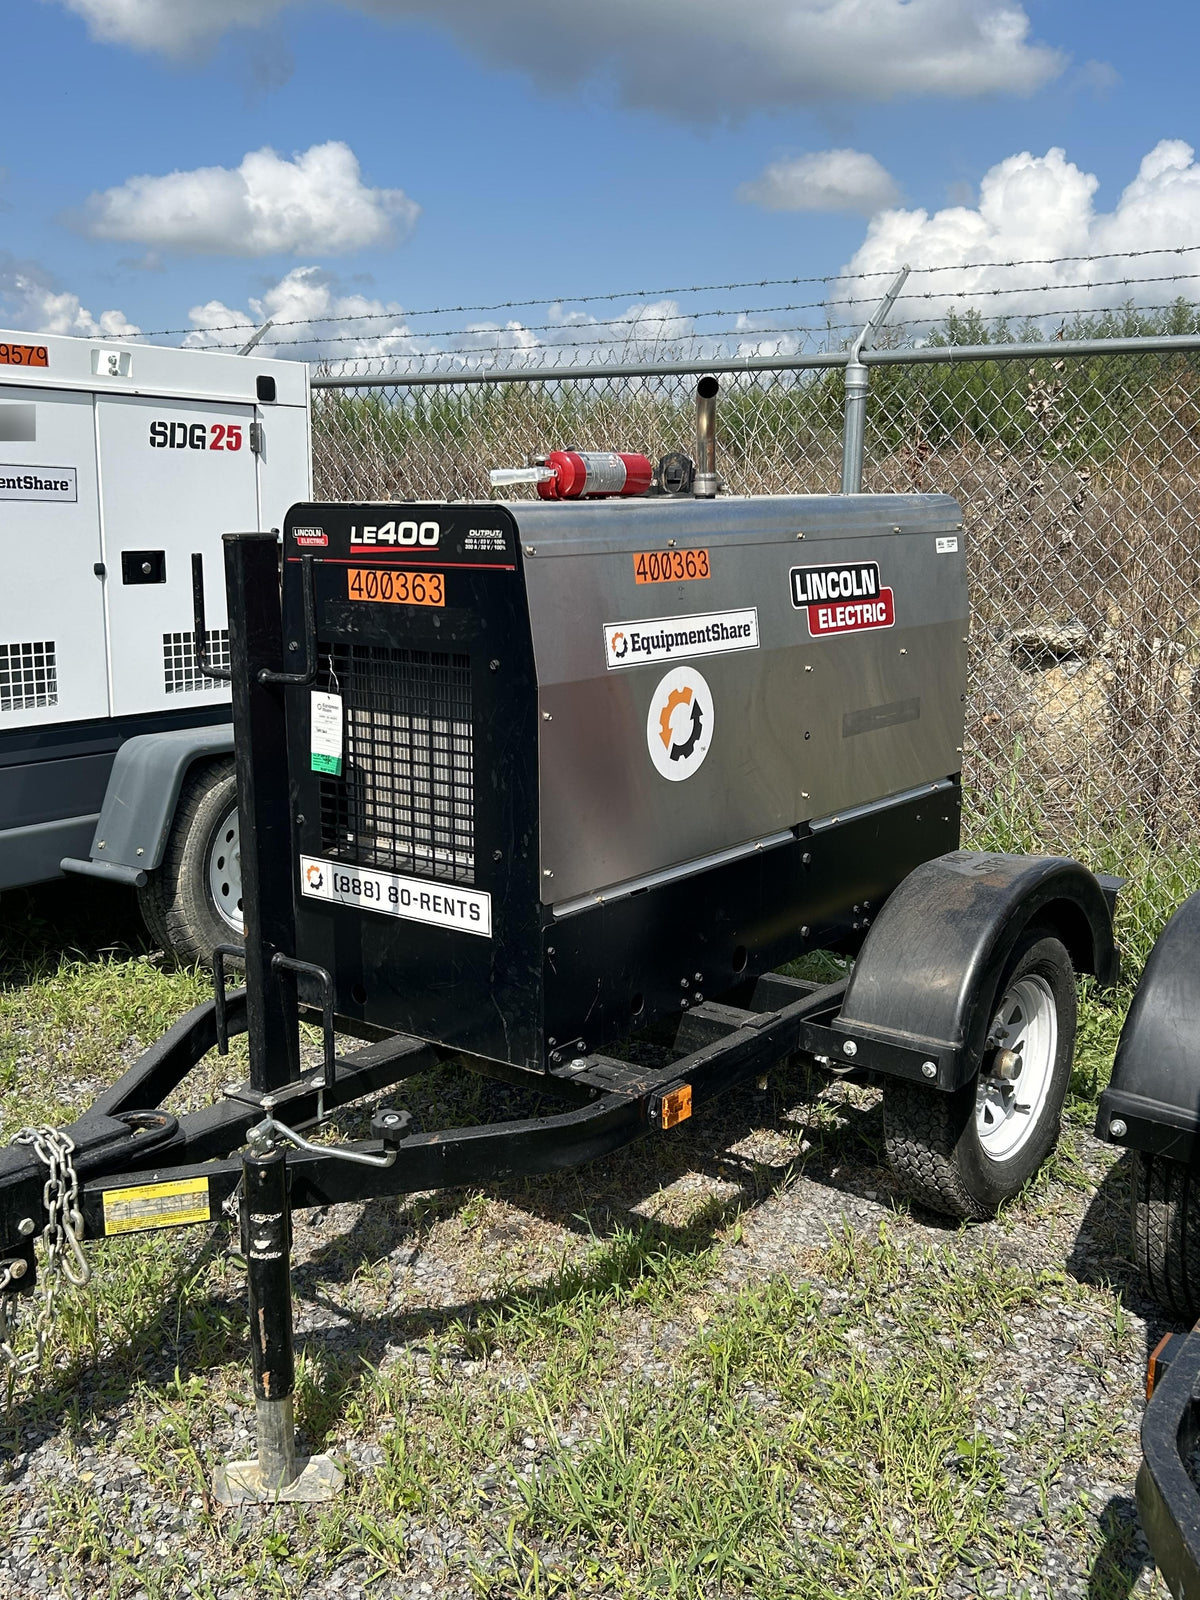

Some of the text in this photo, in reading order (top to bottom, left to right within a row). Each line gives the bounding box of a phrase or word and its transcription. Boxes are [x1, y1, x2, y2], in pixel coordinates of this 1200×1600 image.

[294, 529, 322, 537] LINCOLN
[350, 520, 440, 546] LE400
[469, 529, 501, 537] OUTPUT
[636, 550, 709, 582] 400363
[350, 570, 443, 604] 400363
[795, 568, 876, 602] LINCOLN
[818, 602, 887, 629] ELECTRIC
[630, 623, 751, 655] EquipmentShare
[333, 872, 481, 921] (888) 80-RENTS
